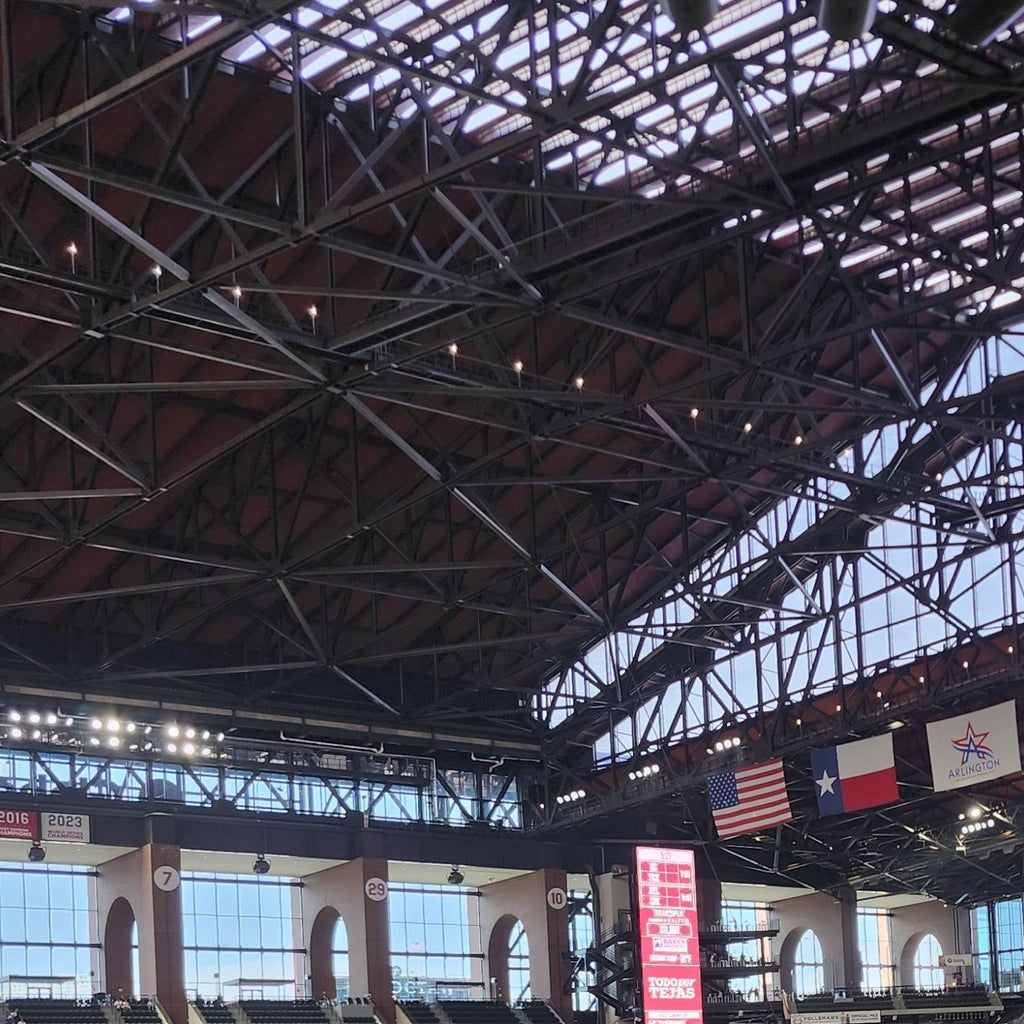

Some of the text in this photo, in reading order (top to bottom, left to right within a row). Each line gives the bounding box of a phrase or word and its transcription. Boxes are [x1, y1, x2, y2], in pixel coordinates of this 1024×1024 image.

[949, 759, 1000, 779] ARLINGTON
[0, 811, 29, 825] 2016
[48, 815, 82, 828] 2023
[162, 872, 173, 886] 7
[368, 883, 385, 896] 29
[551, 892, 563, 905] 10
[648, 986, 696, 999] TEJAS
